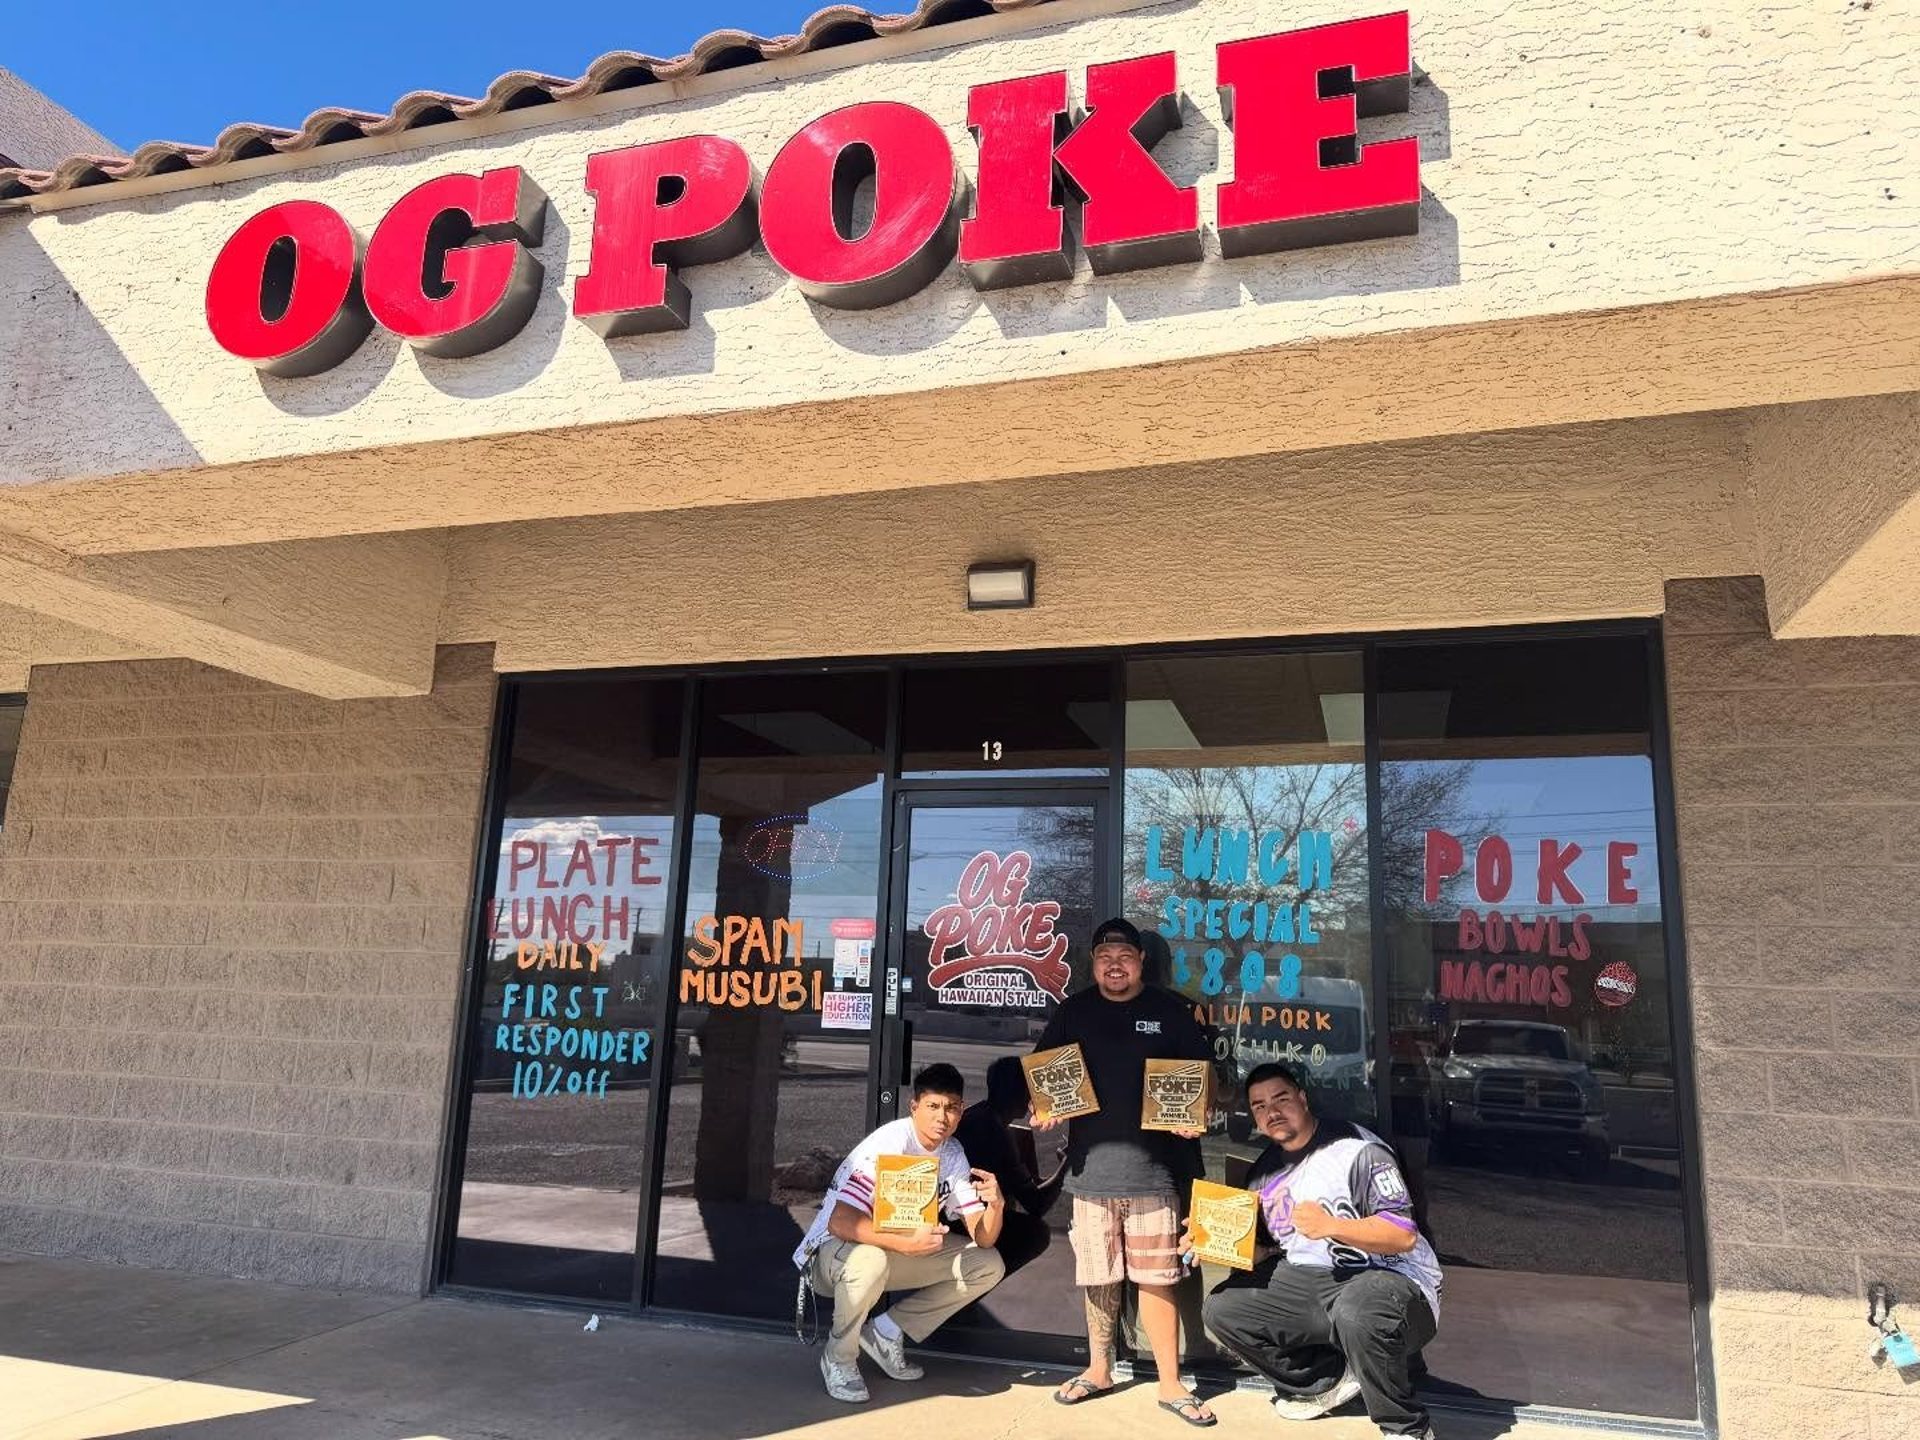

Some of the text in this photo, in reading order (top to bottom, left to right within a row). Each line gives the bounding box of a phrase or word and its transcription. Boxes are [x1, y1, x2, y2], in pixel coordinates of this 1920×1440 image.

[206, 11, 1423, 366] OG POKE
[982, 741, 1002, 760] 13
[509, 835, 663, 892] PLATE
[1144, 824, 1335, 892] LUNCH
[1423, 827, 1639, 905] POKE
[958, 850, 1031, 910] OG
[486, 895, 630, 945] LUNCH
[924, 901, 1061, 966] POKE
[1158, 894, 1321, 945] SPECIAL
[1457, 908, 1594, 961] BOWLS
[517, 940, 608, 973] DAILY
[688, 914, 804, 968] SPAM
[680, 968, 823, 1011] MUSUBI
[887, 971, 898, 998] PULL
[938, 990, 1047, 1007] HAWAIIAN STYLE
[964, 972, 1028, 988] ORIGINAL
[1440, 959, 1572, 1008] NACHOS
[502, 983, 610, 1020] FIRST
[823, 1012, 871, 1021] EDUCATION
[824, 1002, 872, 1013] HIGHER
[1187, 1003, 1332, 1032] ALUA PORK
[495, 1024, 650, 1065] RESPONDER
[1034, 1061, 1082, 1089] POKE
[1151, 1080, 1202, 1094] POKE
